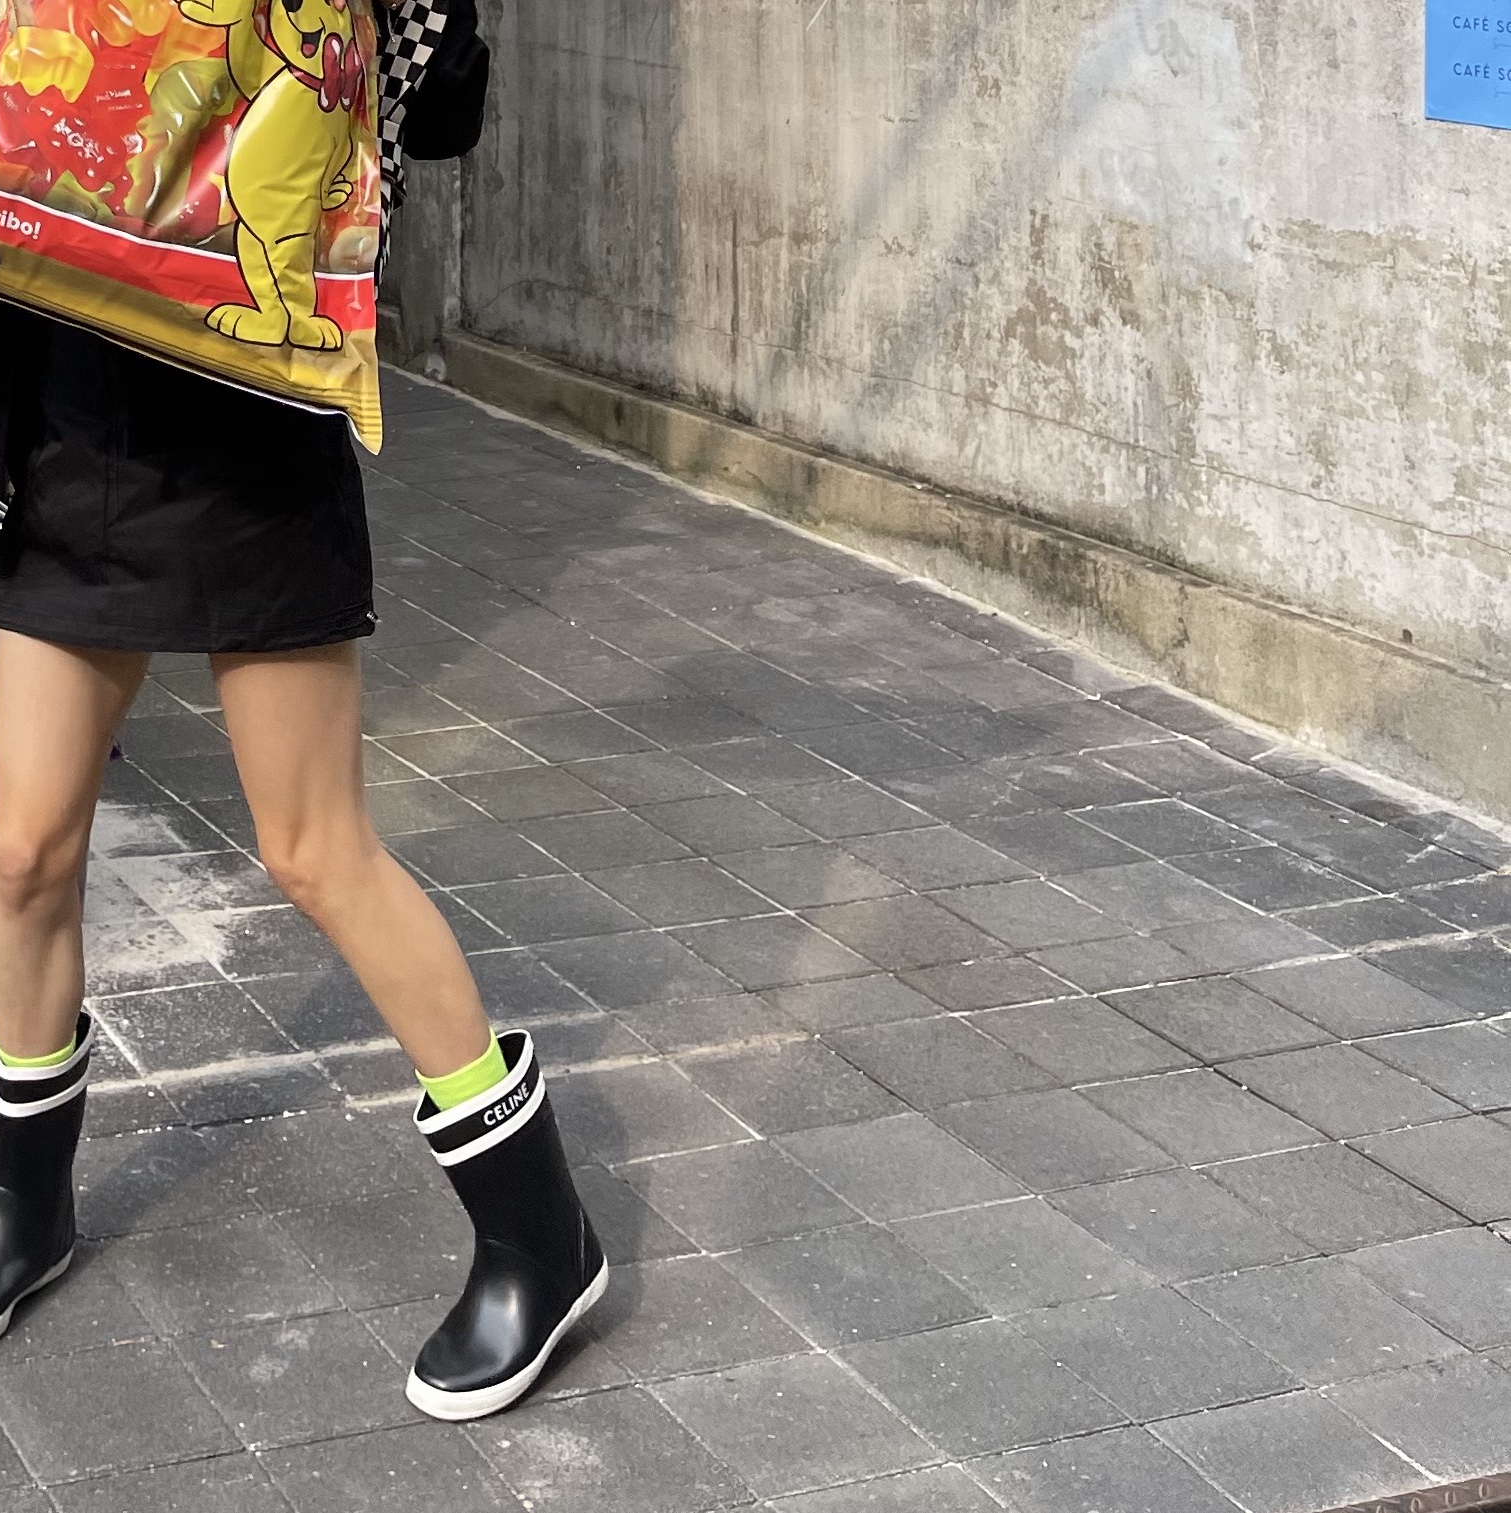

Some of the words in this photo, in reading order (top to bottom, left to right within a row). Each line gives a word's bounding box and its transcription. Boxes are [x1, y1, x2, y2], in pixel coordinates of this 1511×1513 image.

[1452, 16, 1489, 32] CAFÉ
[1453, 62, 1490, 79] CAFÉ
[483, 1082, 530, 1126] CELINE
